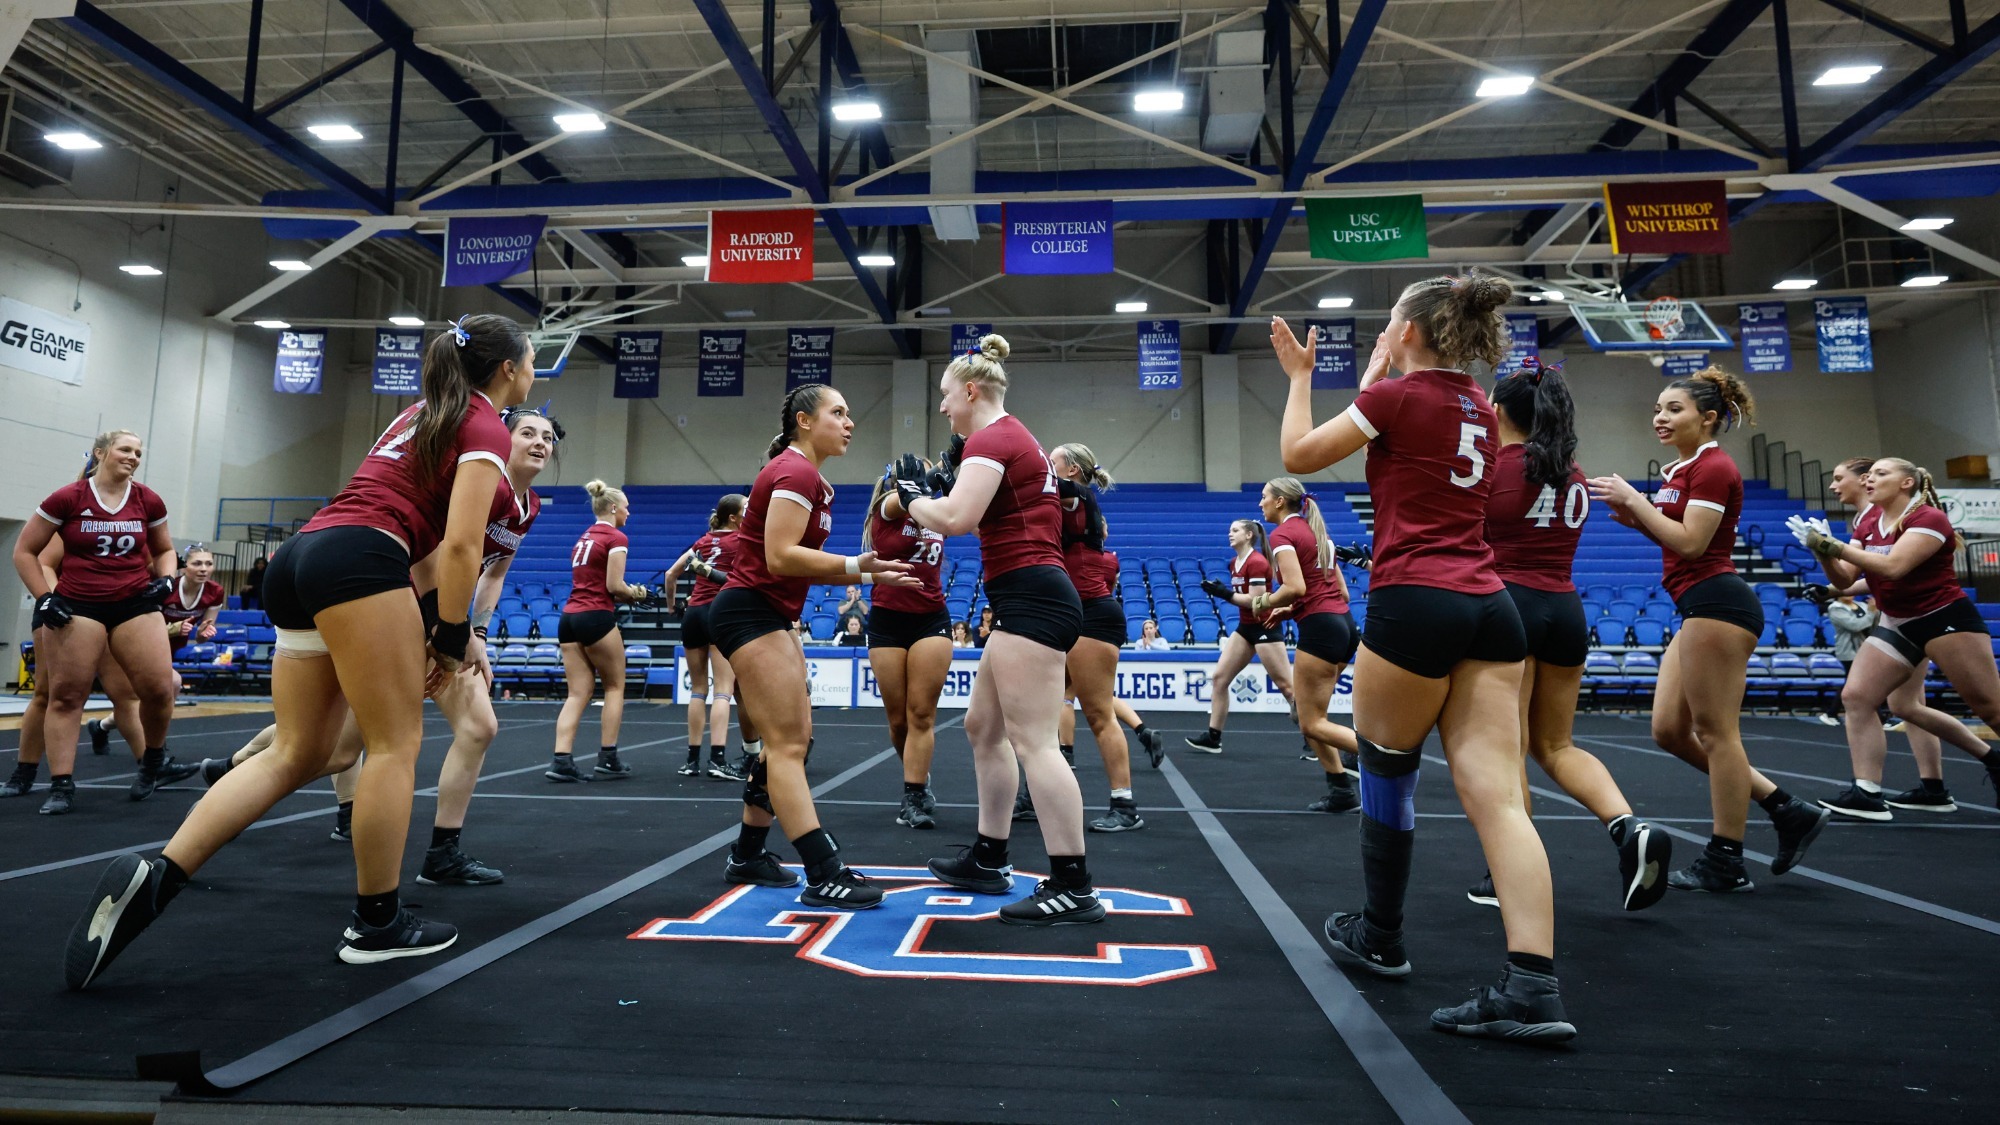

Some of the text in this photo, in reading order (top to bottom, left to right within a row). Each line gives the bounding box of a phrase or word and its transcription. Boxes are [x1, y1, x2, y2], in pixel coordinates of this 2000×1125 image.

[1626, 202, 1713, 217] WINTHROP
[1014, 220, 1106, 235] PRESBYTERIAN
[1349, 213, 1380, 227] USC
[1625, 218, 1719, 233] UNIVERSITY
[459, 234, 532, 250] LONGWOOD
[729, 232, 794, 246] RADFORD
[1333, 227, 1401, 243] UPSTATE
[720, 247, 803, 262] UNIVERSITY
[1031, 239, 1089, 254] COLLEGE
[456, 248, 530, 265] UNIVERSITY
[1739, 305, 1759, 322] PC
[1815, 300, 1833, 317] PC
[965, 324, 979, 337] PC
[1152, 321, 1164, 332] PC
[31, 327, 85, 354] GAME
[280, 331, 299, 349] PC
[378, 333, 396, 350] PC
[619, 337, 636, 353] PC
[702, 336, 719, 352] PC
[790, 334, 807, 350] PC
[30, 340, 68, 362] ONE
[377, 351, 420, 359] BASKETBALL
[1143, 374, 1177, 386] 2024
[1449, 421, 1488, 488] 5
[1523, 481, 1589, 529] 40
[94, 534, 136, 557] 39
[571, 539, 595, 568] 21
[908, 542, 942, 566] 28
[821, 684, 851, 693] Center
[1113, 672, 1176, 700] LEGE
